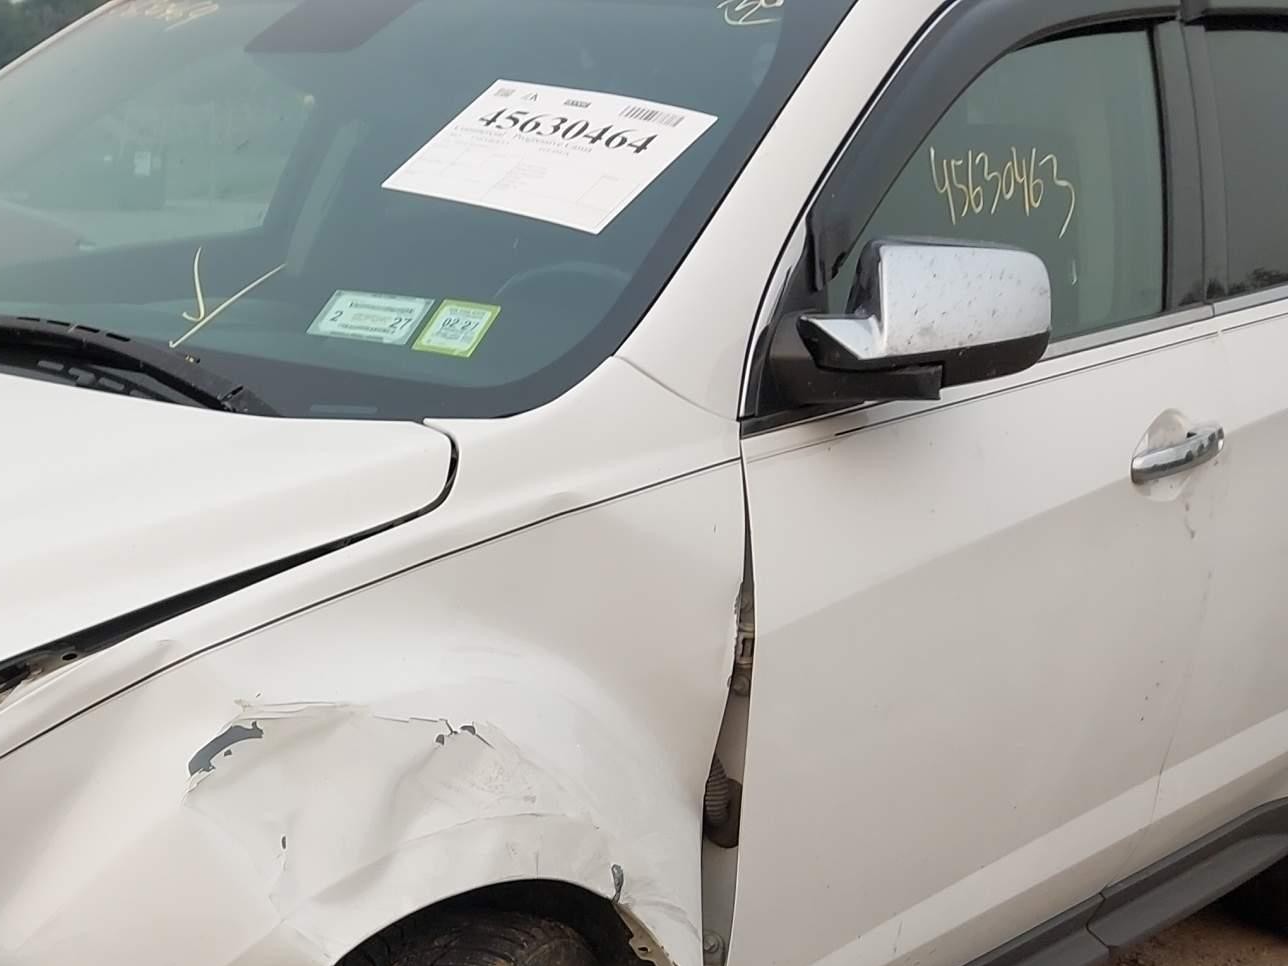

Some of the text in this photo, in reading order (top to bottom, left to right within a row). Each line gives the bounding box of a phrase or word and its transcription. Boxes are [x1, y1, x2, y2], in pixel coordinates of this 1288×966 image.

[479, 107, 660, 154] 45630464
[930, 146, 1075, 239] 45630463
[330, 311, 345, 323] 2
[389, 317, 413, 331] 27
